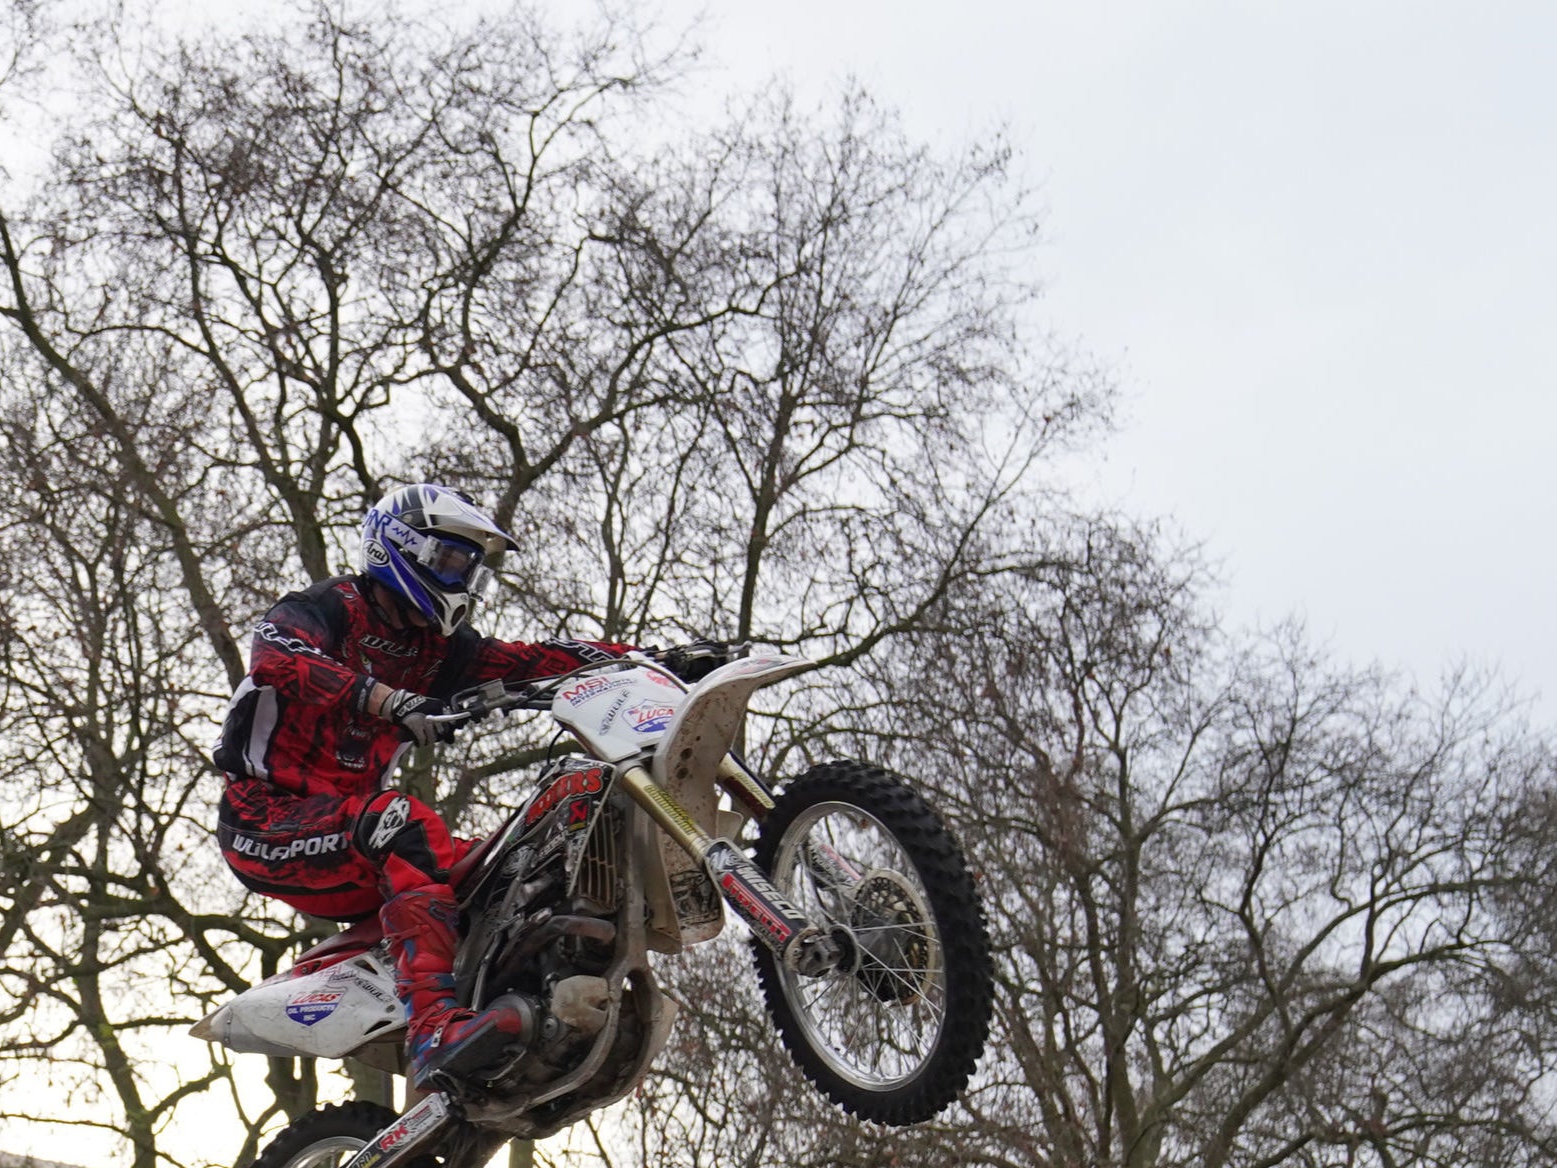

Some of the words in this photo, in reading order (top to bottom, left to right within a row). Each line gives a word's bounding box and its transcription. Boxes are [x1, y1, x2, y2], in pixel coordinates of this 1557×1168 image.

[365, 541, 386, 561] Arai
[562, 676, 610, 700] MSI
[735, 865, 807, 920] WISECO
[379, 1124, 409, 1151] RK
